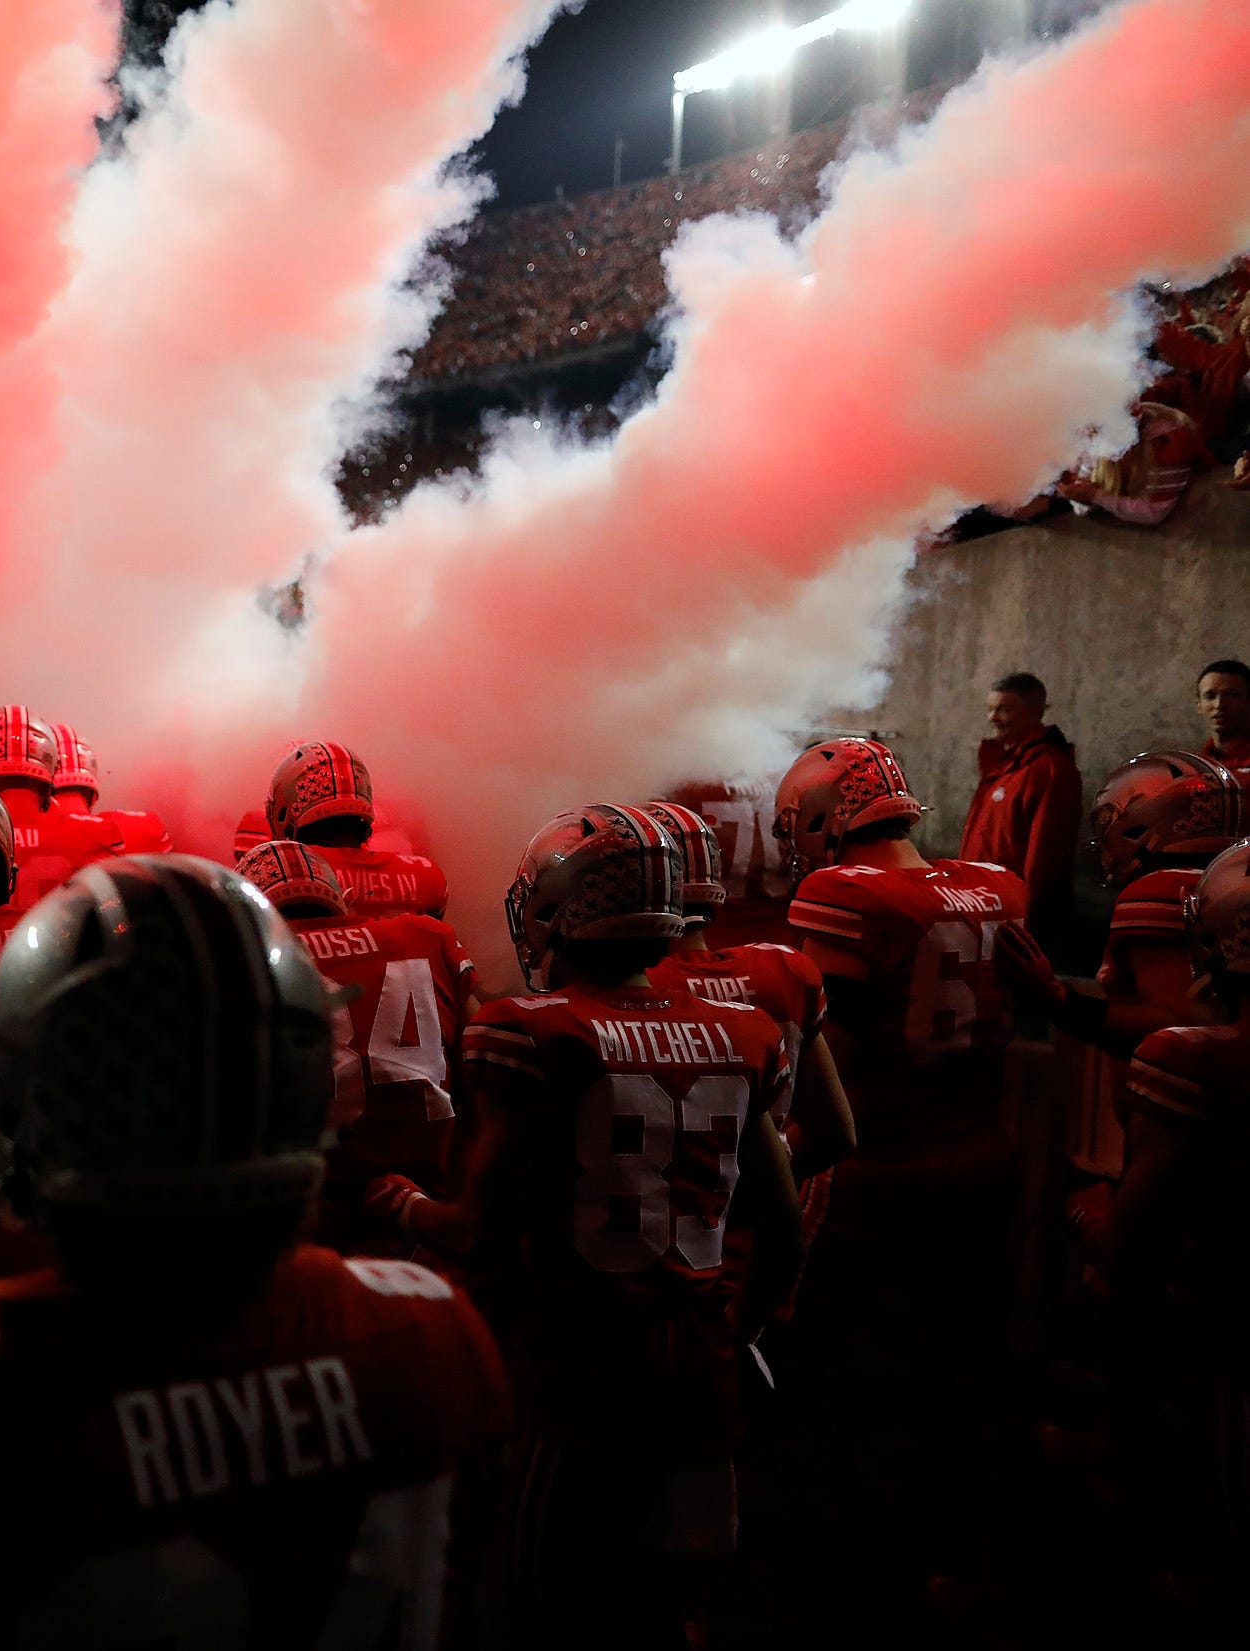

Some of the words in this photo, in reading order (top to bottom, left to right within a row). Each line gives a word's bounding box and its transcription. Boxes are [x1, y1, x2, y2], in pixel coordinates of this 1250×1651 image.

[14, 828, 39, 847] AU
[335, 869, 395, 901] AVIES
[933, 885, 1002, 912] JAMES
[687, 975, 756, 1004] COPE
[591, 1019, 744, 1064] MITCHELL
[572, 1074, 750, 1273] 83
[112, 1355, 374, 1512] ROYER
